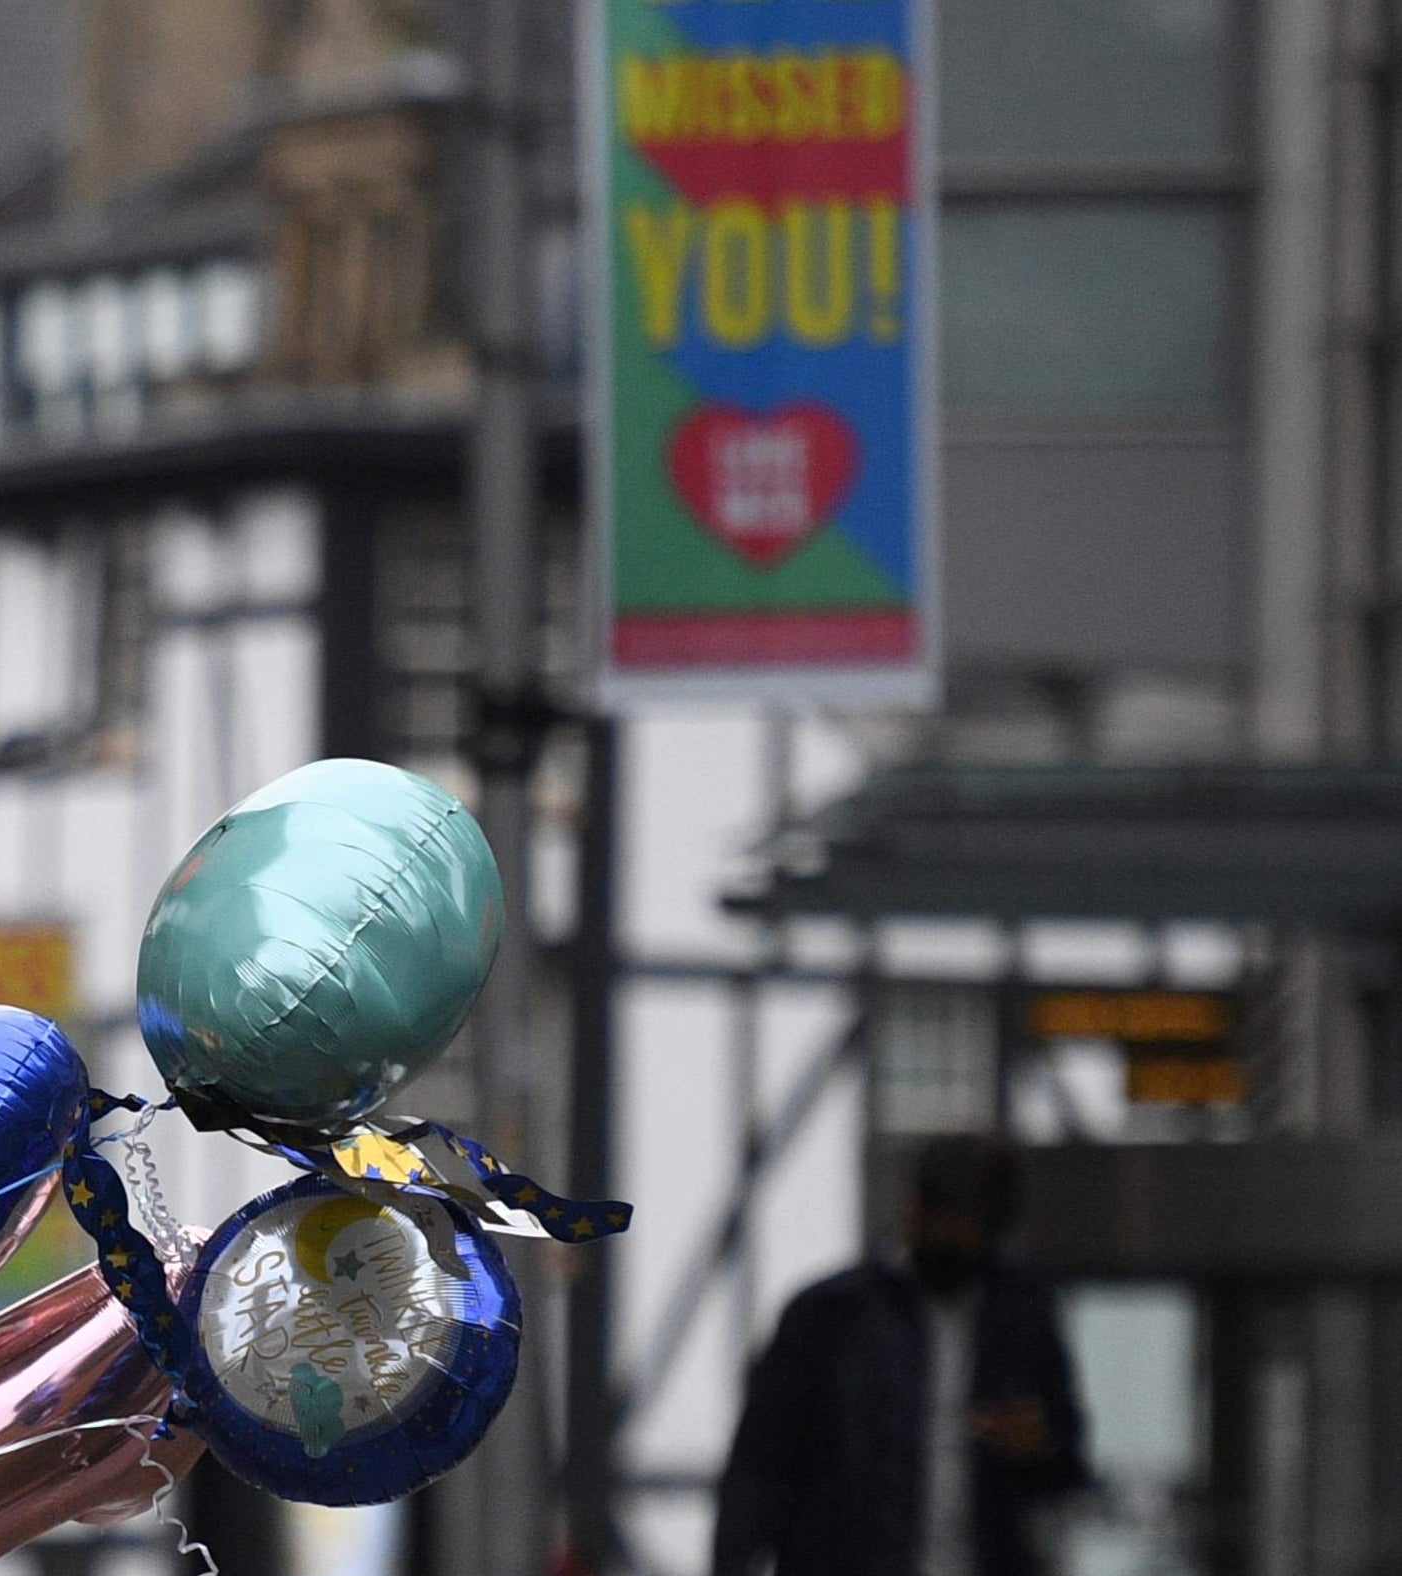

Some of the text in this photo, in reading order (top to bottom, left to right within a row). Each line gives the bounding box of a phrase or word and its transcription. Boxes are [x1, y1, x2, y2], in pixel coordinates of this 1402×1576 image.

[617, 48, 907, 143] MISSED
[622, 195, 905, 347] YOU!
[231, 1250, 289, 1374] STAR
[291, 1283, 355, 1374] little
[336, 1289, 410, 1398] twinkle
[364, 1231, 447, 1358] TWINKLE
